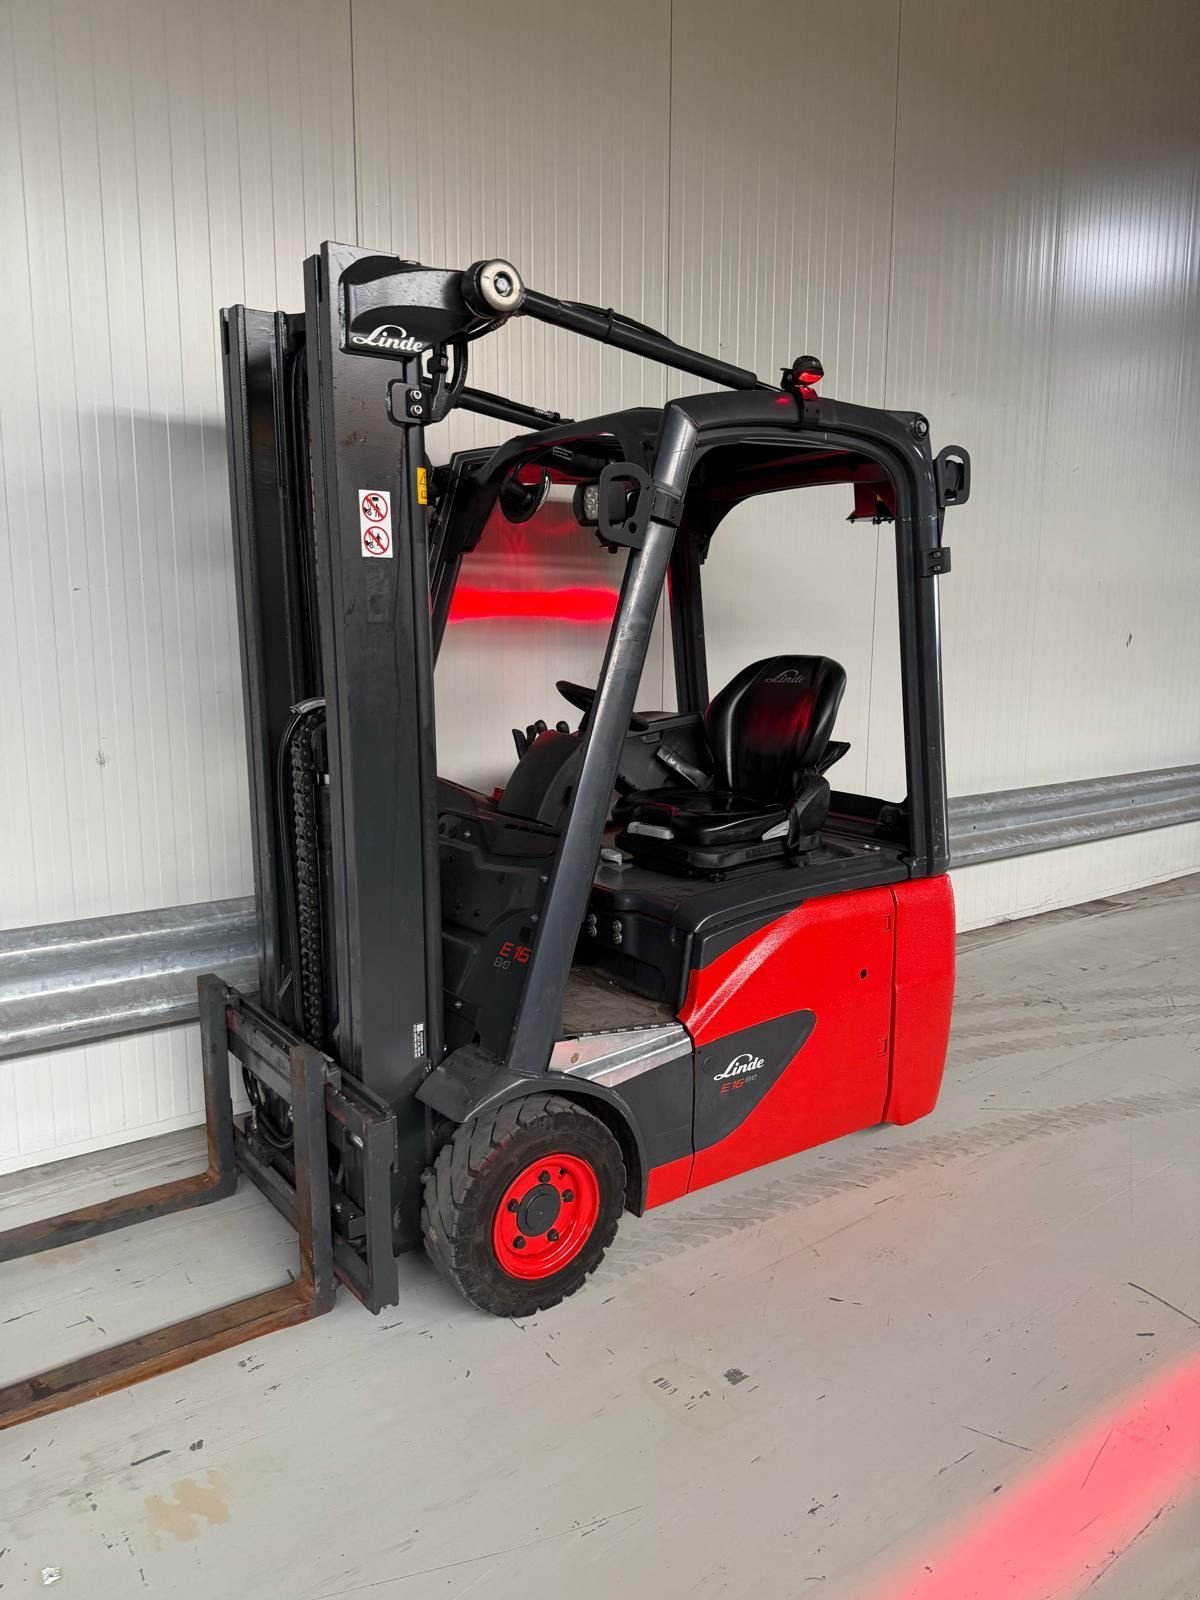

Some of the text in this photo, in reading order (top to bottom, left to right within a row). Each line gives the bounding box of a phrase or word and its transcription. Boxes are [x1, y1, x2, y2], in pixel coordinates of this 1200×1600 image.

[352, 324, 423, 353] Linde
[499, 941, 532, 963] E 16
[713, 1053, 765, 1081] Linde
[720, 1082, 730, 1094] E
[732, 1078, 745, 1090] 16
